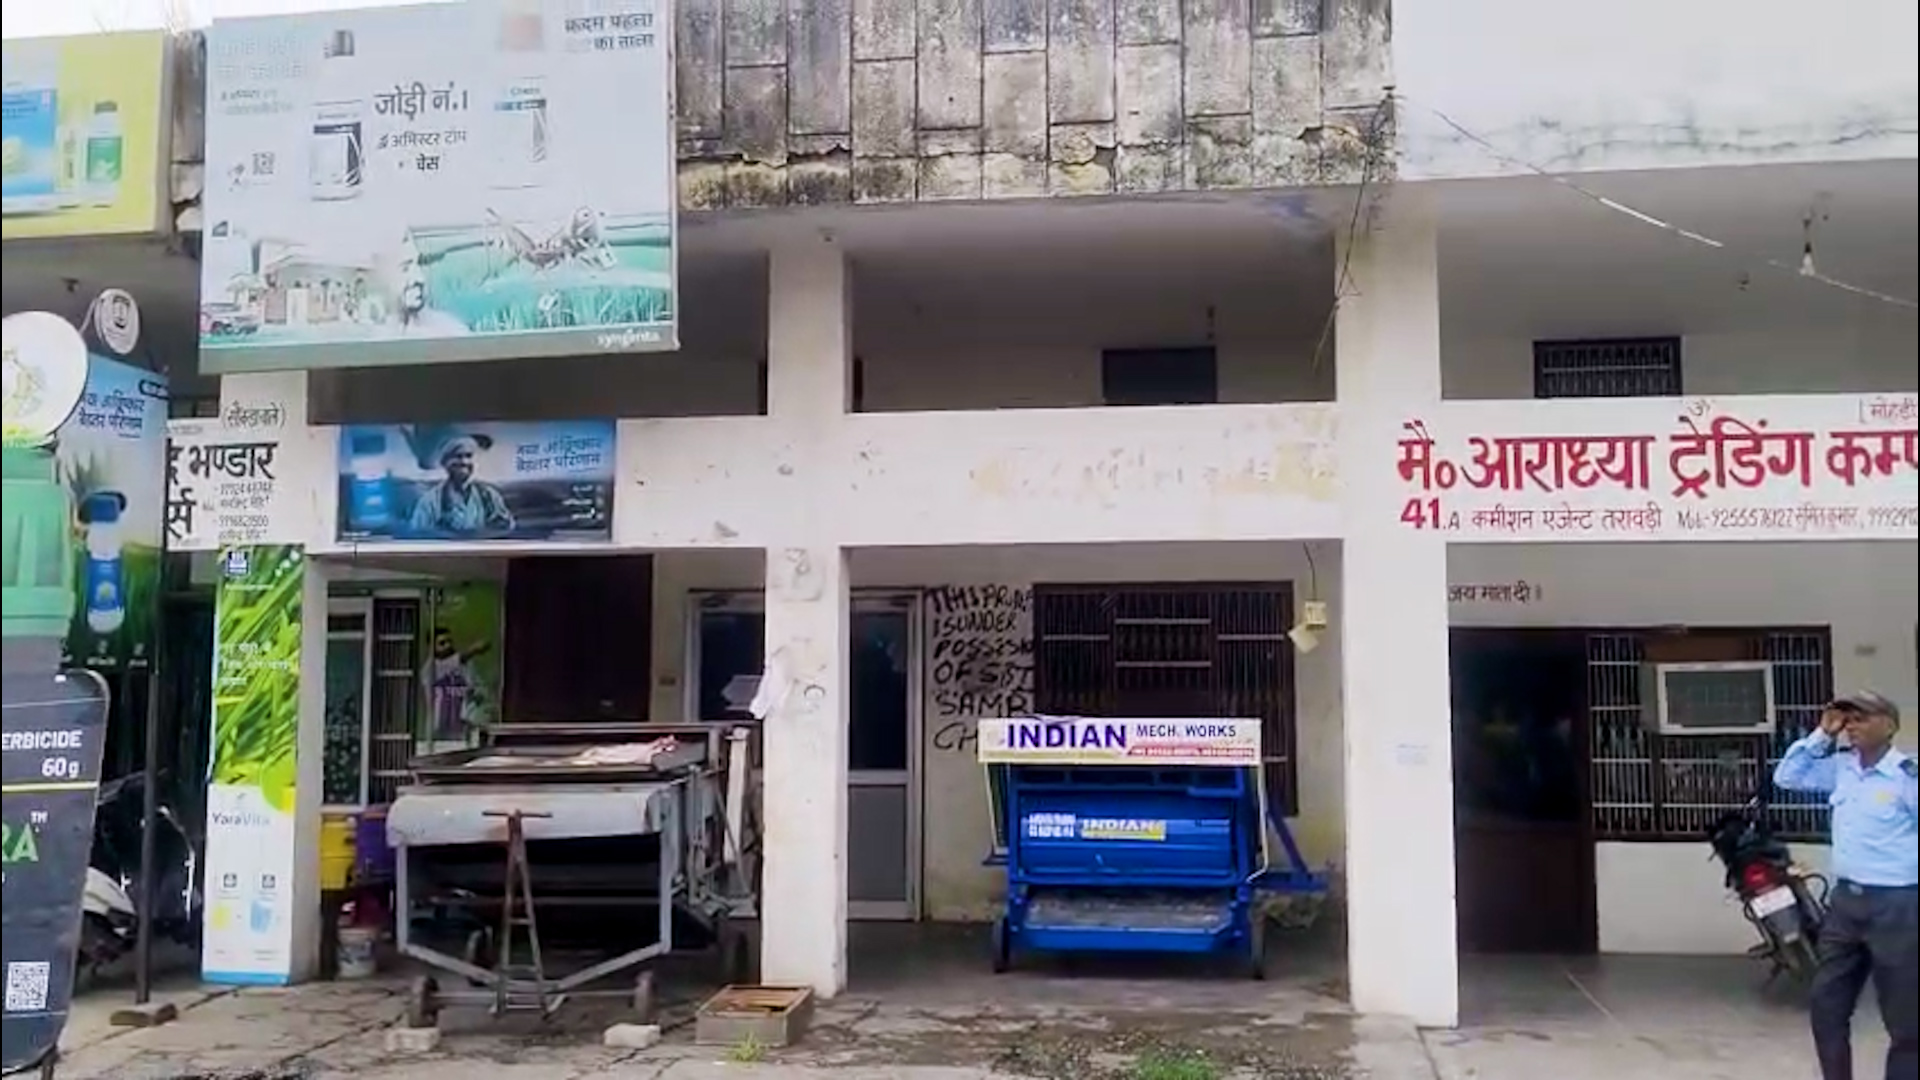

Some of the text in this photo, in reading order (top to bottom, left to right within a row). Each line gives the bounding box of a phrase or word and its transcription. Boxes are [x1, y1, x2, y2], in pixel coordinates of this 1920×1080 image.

[189, 441, 279, 479] भण्डार
[1461, 435, 1656, 493] आराध्या
[1669, 415, 1815, 499] ट्रेडिंग
[1007, 723, 1127, 748] INDIAN
[1186, 724, 1236, 737] WORKS
